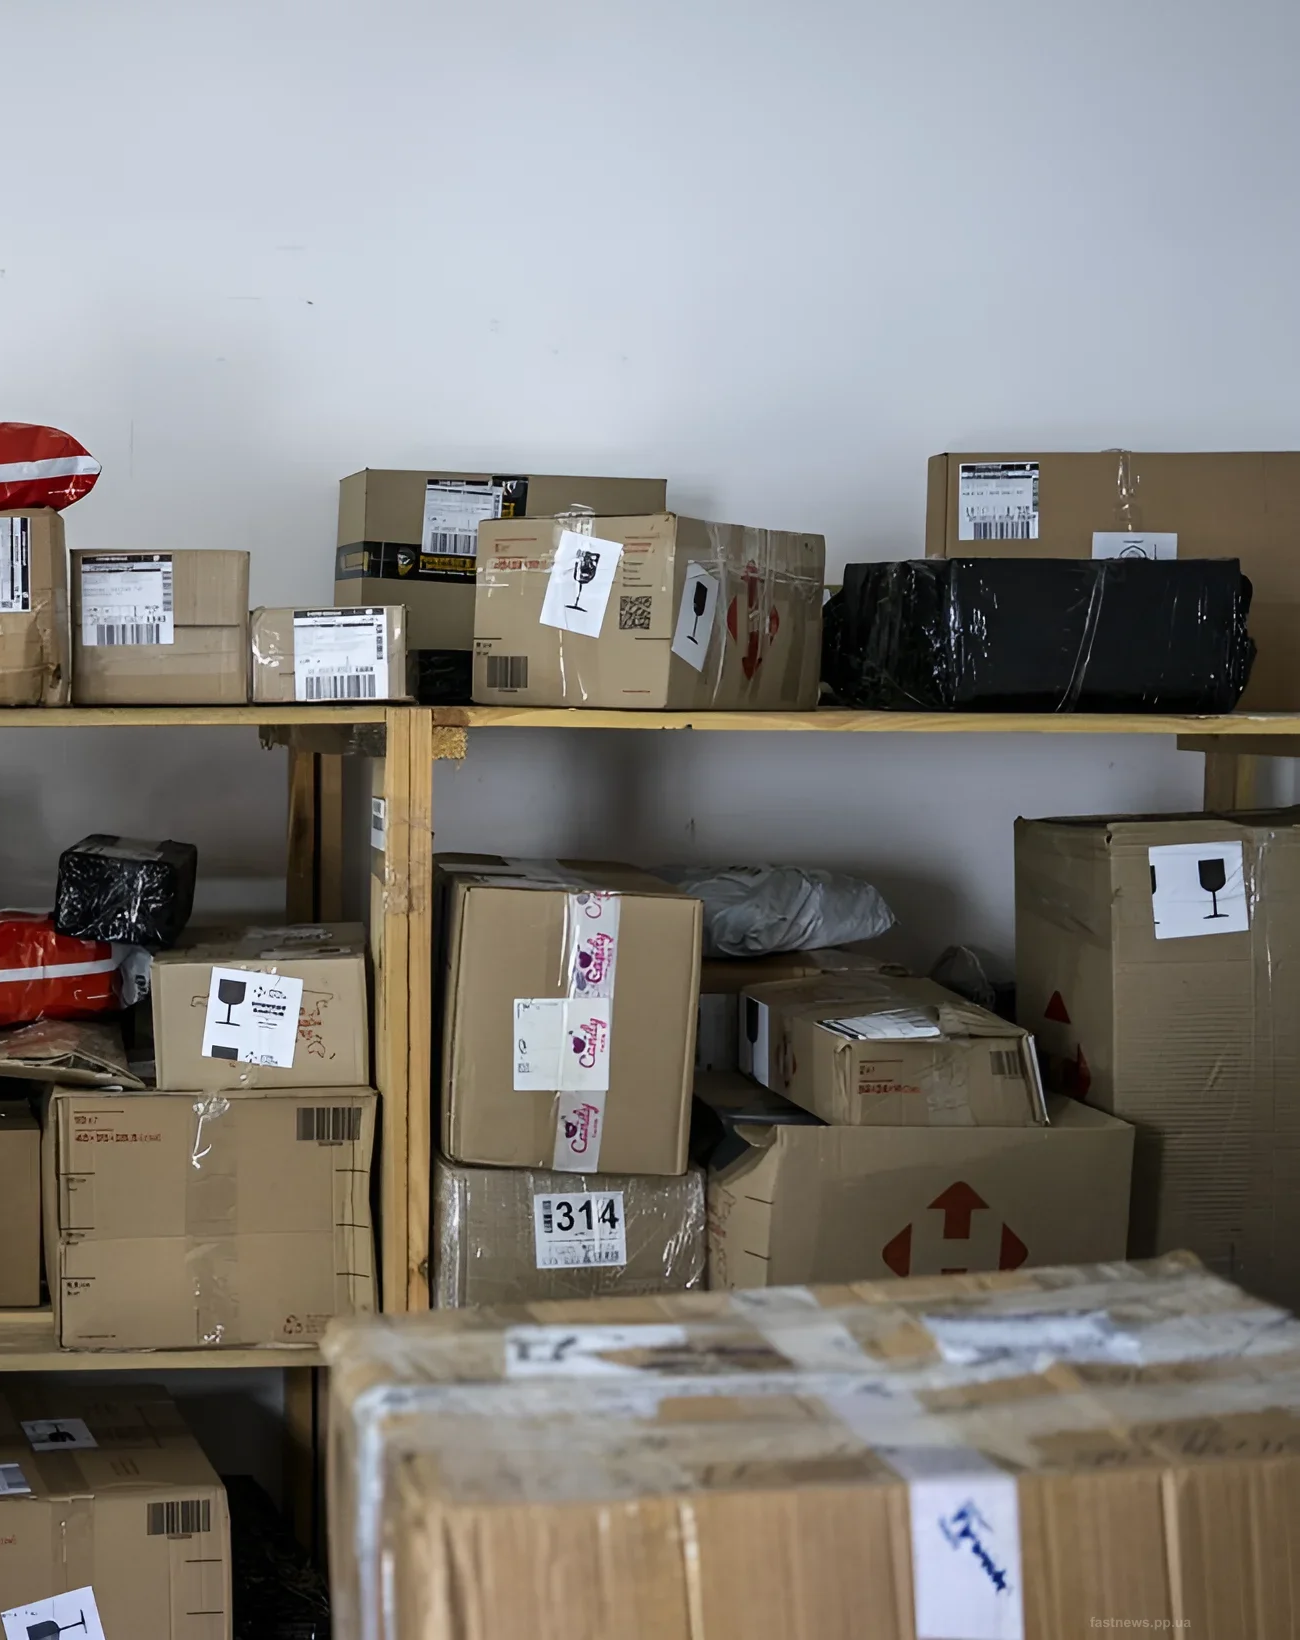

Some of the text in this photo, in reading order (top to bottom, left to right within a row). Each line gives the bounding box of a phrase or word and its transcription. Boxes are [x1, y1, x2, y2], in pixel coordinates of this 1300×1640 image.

[578, 1017, 608, 1069] Candy
[570, 1103, 600, 1154] Candy
[556, 1199, 619, 1231] 314
